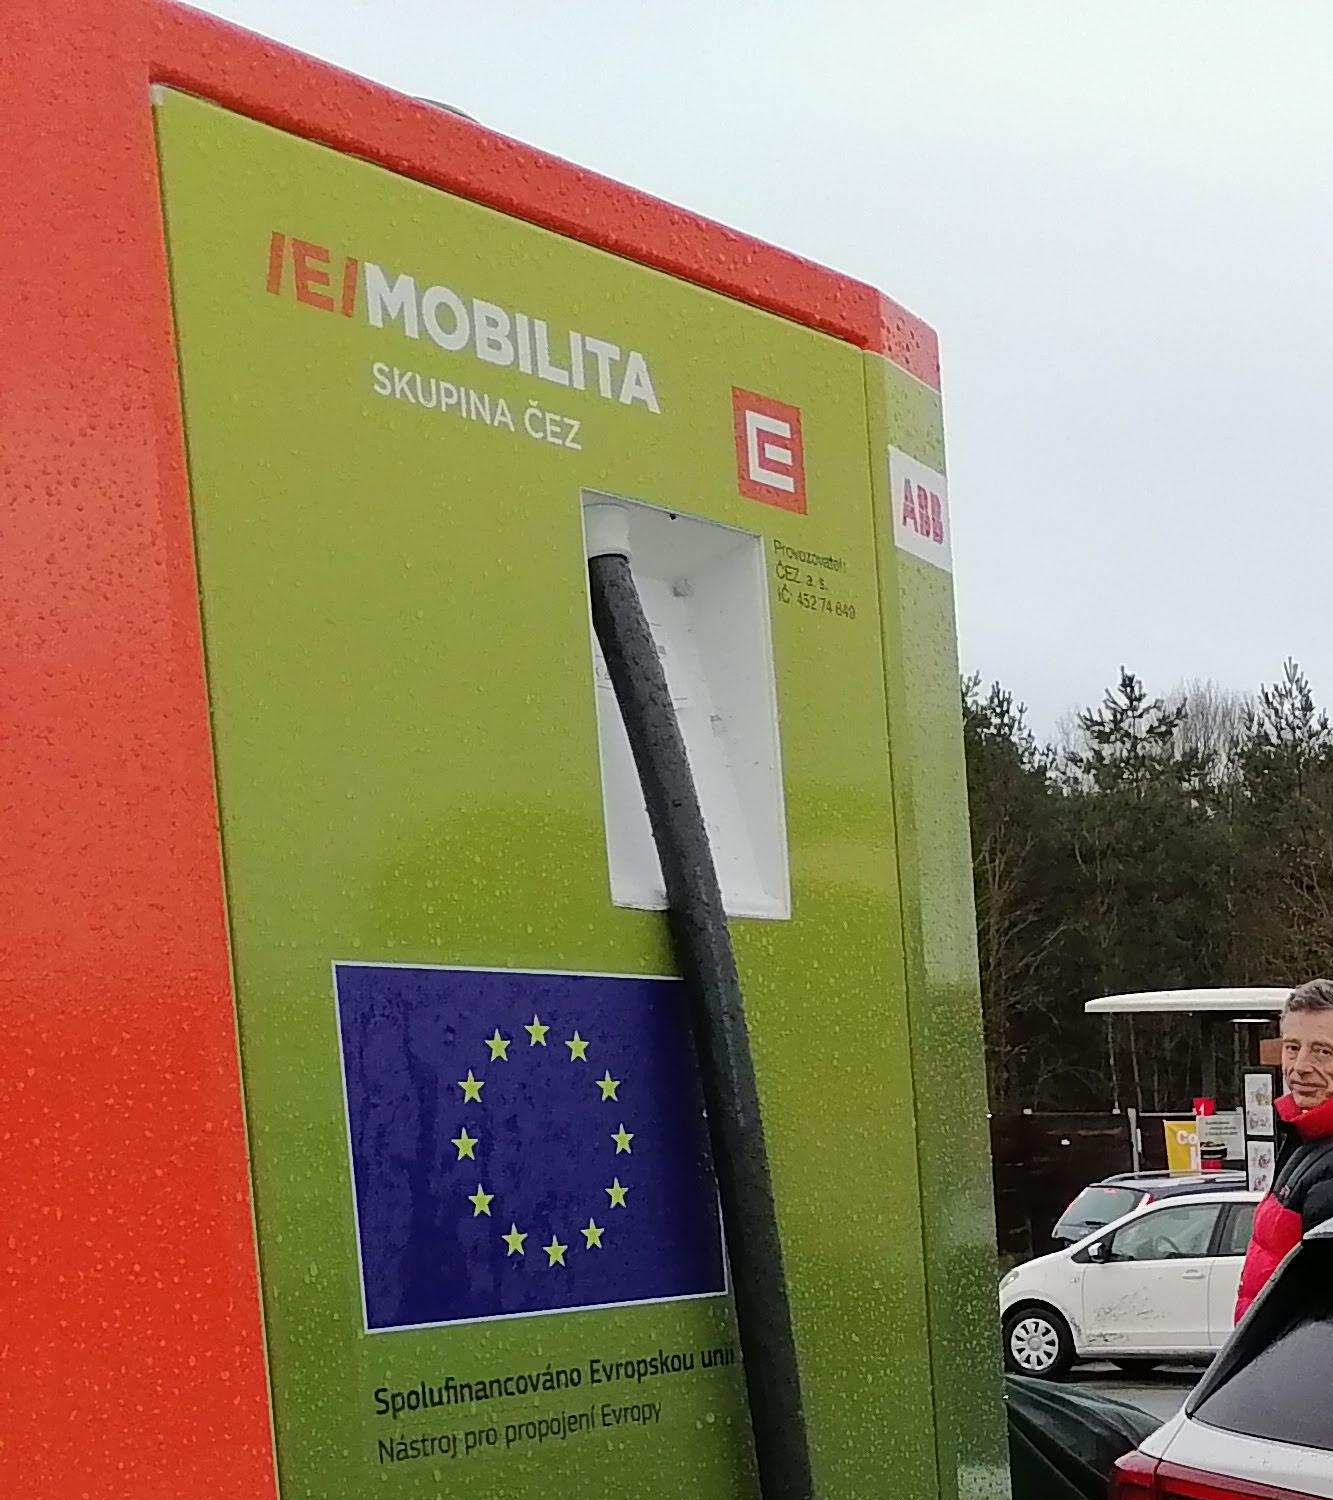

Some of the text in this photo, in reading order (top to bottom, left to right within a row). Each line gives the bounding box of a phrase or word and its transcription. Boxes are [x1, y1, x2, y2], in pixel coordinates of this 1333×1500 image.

[372, 361, 582, 450] SKUPINA ČEZ
[902, 478, 944, 544] ABB
[374, 1363, 582, 1420] Spolufinancováno
[589, 1349, 695, 1384] Evropskou
[378, 1402, 662, 1465] Nástroj pro propojení Evropy
